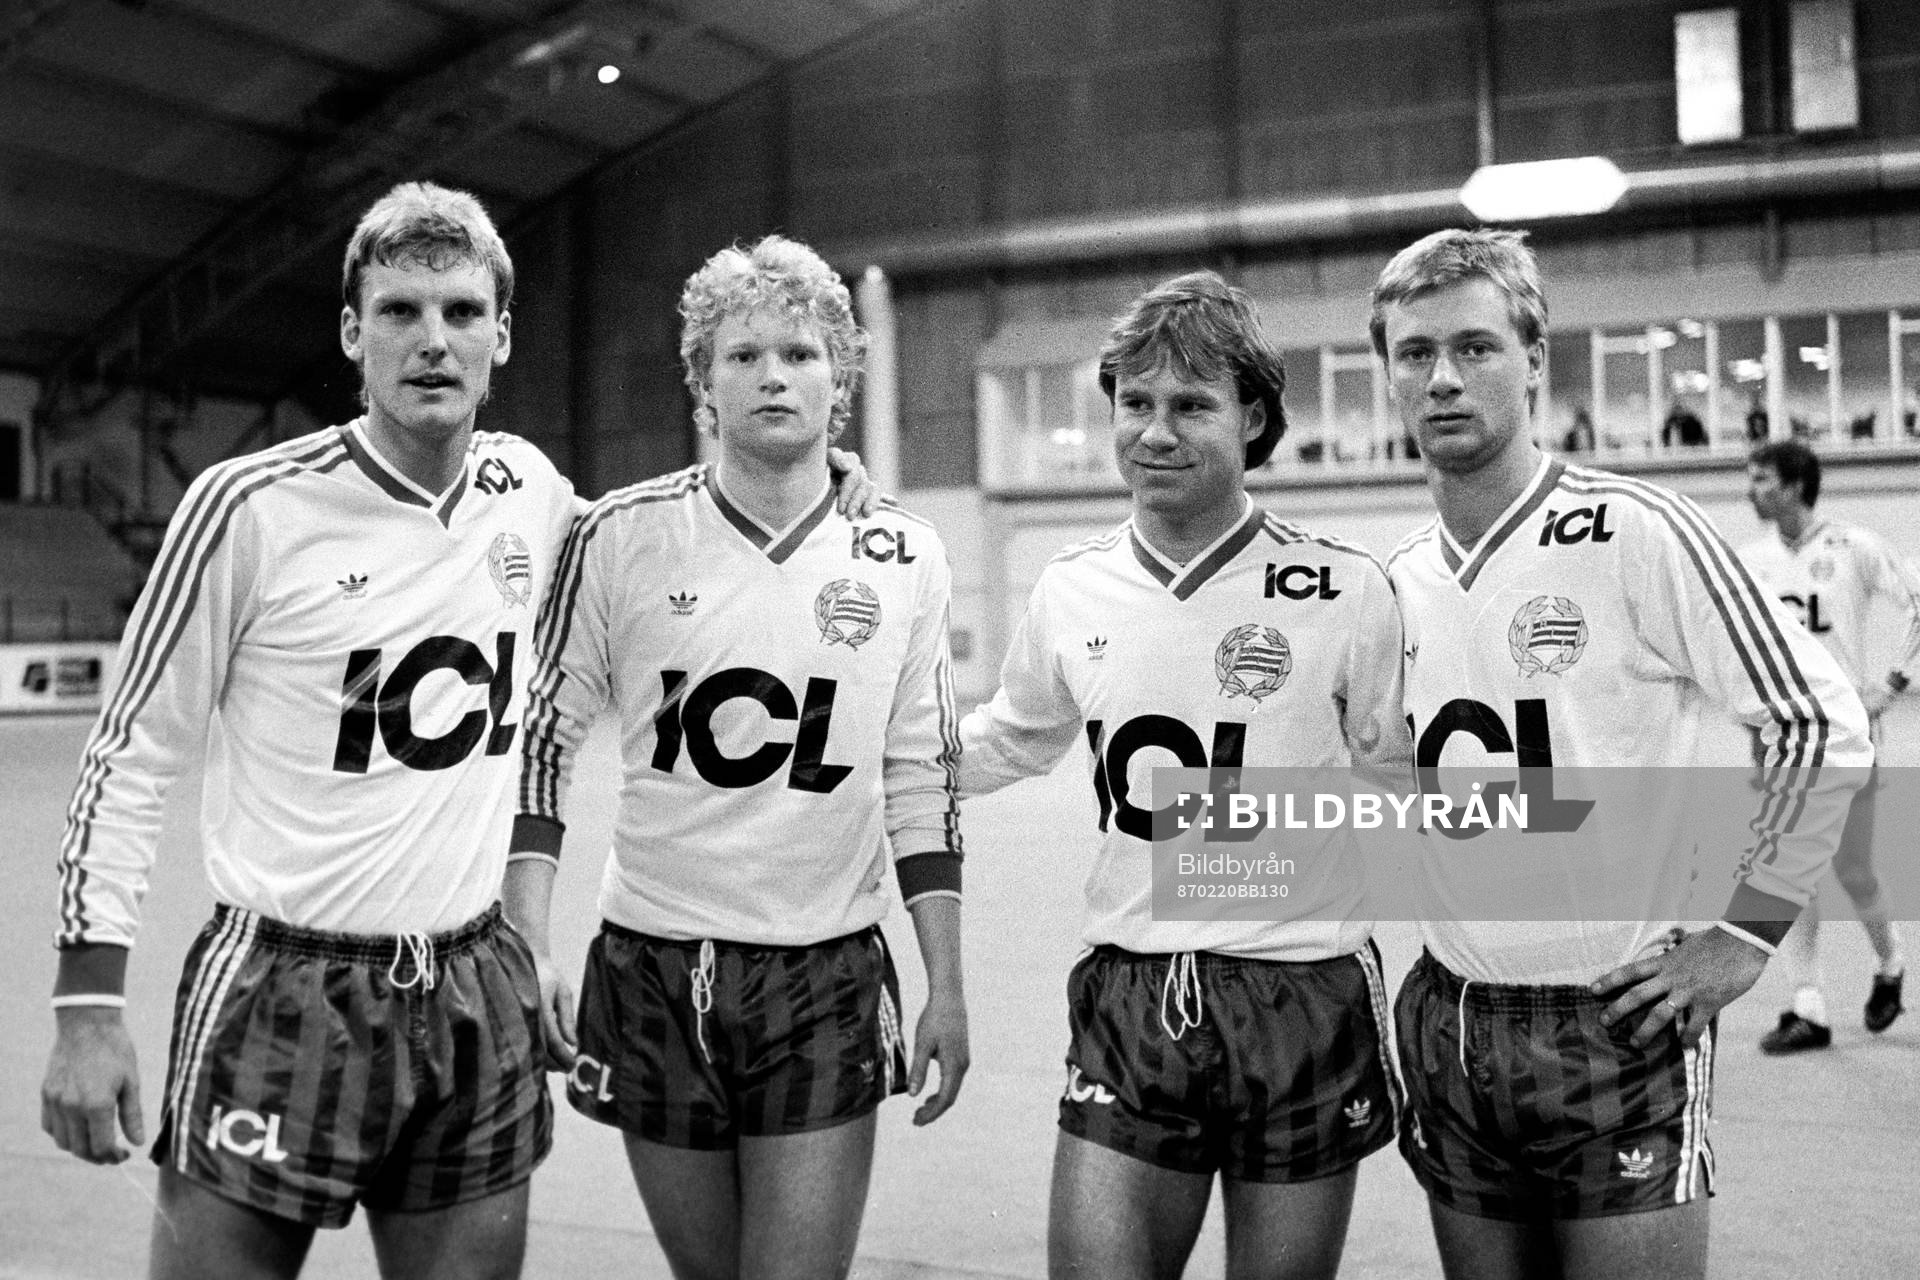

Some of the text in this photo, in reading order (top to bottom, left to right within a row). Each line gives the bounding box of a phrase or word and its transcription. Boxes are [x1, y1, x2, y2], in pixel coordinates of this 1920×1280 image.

[851, 526, 917, 565] ICL
[1538, 502, 1616, 547] ICL
[1264, 562, 1343, 600] ICL
[332, 631, 517, 774] ICL
[651, 667, 855, 794] ICL
[1086, 714, 1270, 842] ICL
[1405, 698, 1597, 841] CL
[567, 1054, 615, 1103] CL
[206, 1104, 289, 1163] ICL
